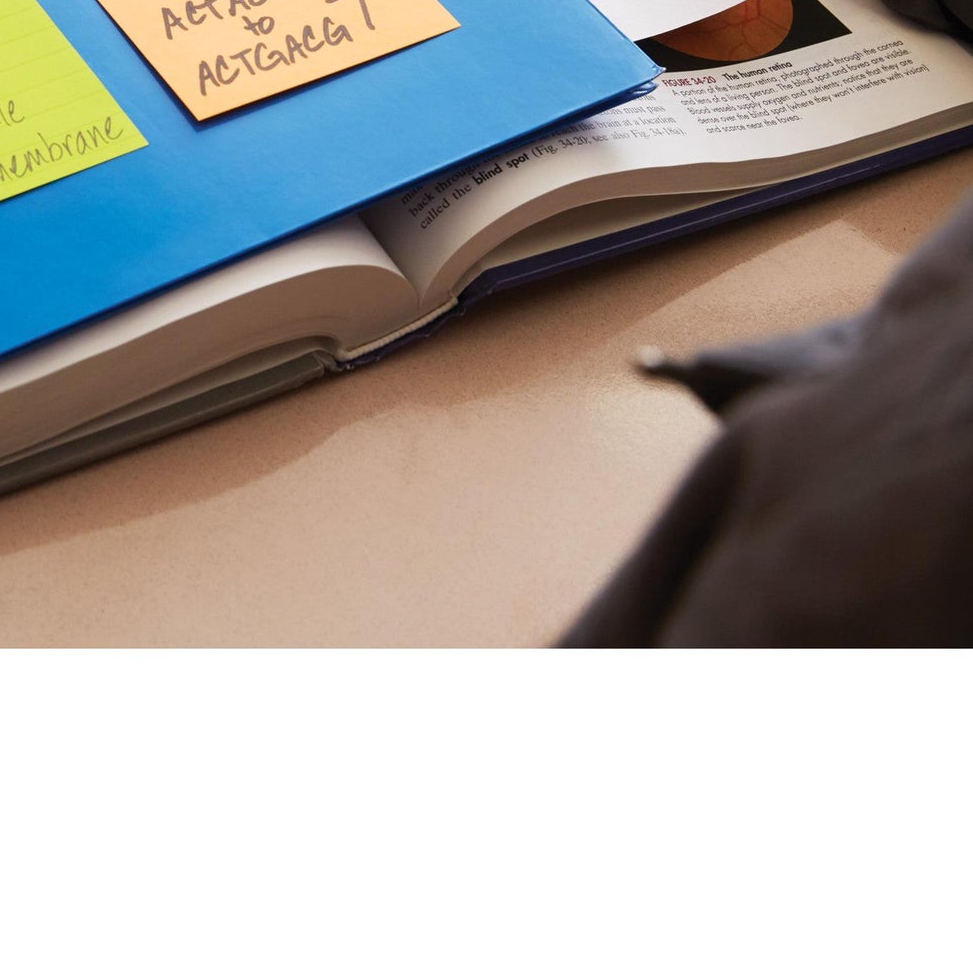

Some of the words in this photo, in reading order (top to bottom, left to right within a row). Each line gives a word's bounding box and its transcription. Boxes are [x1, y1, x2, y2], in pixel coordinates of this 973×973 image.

[243, 15, 276, 37] to
[662, 77, 691, 88] FIGURE
[691, 75, 717, 87] 34-20
[722, 72, 740, 82] The
[739, 66, 768, 79] human
[768, 61, 793, 73] retina
[672, 89, 680, 97] A
[680, 87, 707, 98] portion
[707, 85, 715, 94] of
[715, 83, 728, 92] the
[729, 80, 755, 91] human
[781, 59, 835, 82] photographed
[834, 51, 864, 67] through
[864, 47, 877, 55] the
[877, 40, 904, 52] cornea
[681, 97, 696, 106] and
[696, 96, 712, 105] lens
[712, 94, 720, 103] of
[727, 91, 749, 102] living
[750, 86, 778, 100] person.
[777, 82, 794, 92] The
[792, 76, 814, 88] blind
[815, 71, 831, 83] spot
[832, 67, 848, 77] and
[847, 61, 870, 73] fovea
[871, 56, 885, 64] are
[885, 48, 913, 61] visible.
[687, 105, 712, 115] Blood
[712, 102, 737, 113] vessels
[737, 99, 762, 111] supply
[762, 93, 790, 106] oxygen
[791, 89, 807, 100] and
[842, 72, 867, 85] notice
[866, 67, 881, 77] that
[881, 63, 900, 73] they
[899, 58, 913, 67] are
[697, 115, 720, 125] dense
[720, 112, 737, 123] over
[737, 110, 749, 120] the
[749, 107, 770, 119] blind
[771, 103, 787, 115] spot
[786, 97, 815, 114] (where
[814, 93, 833, 104] they
[833, 86, 855, 99] won't
[855, 78, 887, 93] interfere
[887, 70, 904, 82] with
[596, 118, 624, 130] brain
[624, 119, 633, 127] at
[642, 115, 677, 126] location
[706, 125, 722, 134] and
[723, 122, 747, 133] scarce
[746, 120, 765, 130] near
[764, 118, 777, 127] the
[776, 114, 803, 125] fovea.
[420, 197, 451, 230] called
[452, 183, 472, 201] the
[473, 163, 503, 186] blind
[506, 152, 530, 169] spot
[531, 142, 558, 159] (Fig.
[592, 134, 609, 143] see
[612, 130, 631, 140] also
[632, 128, 651, 140] Fig.
[408, 191, 435, 217] back
